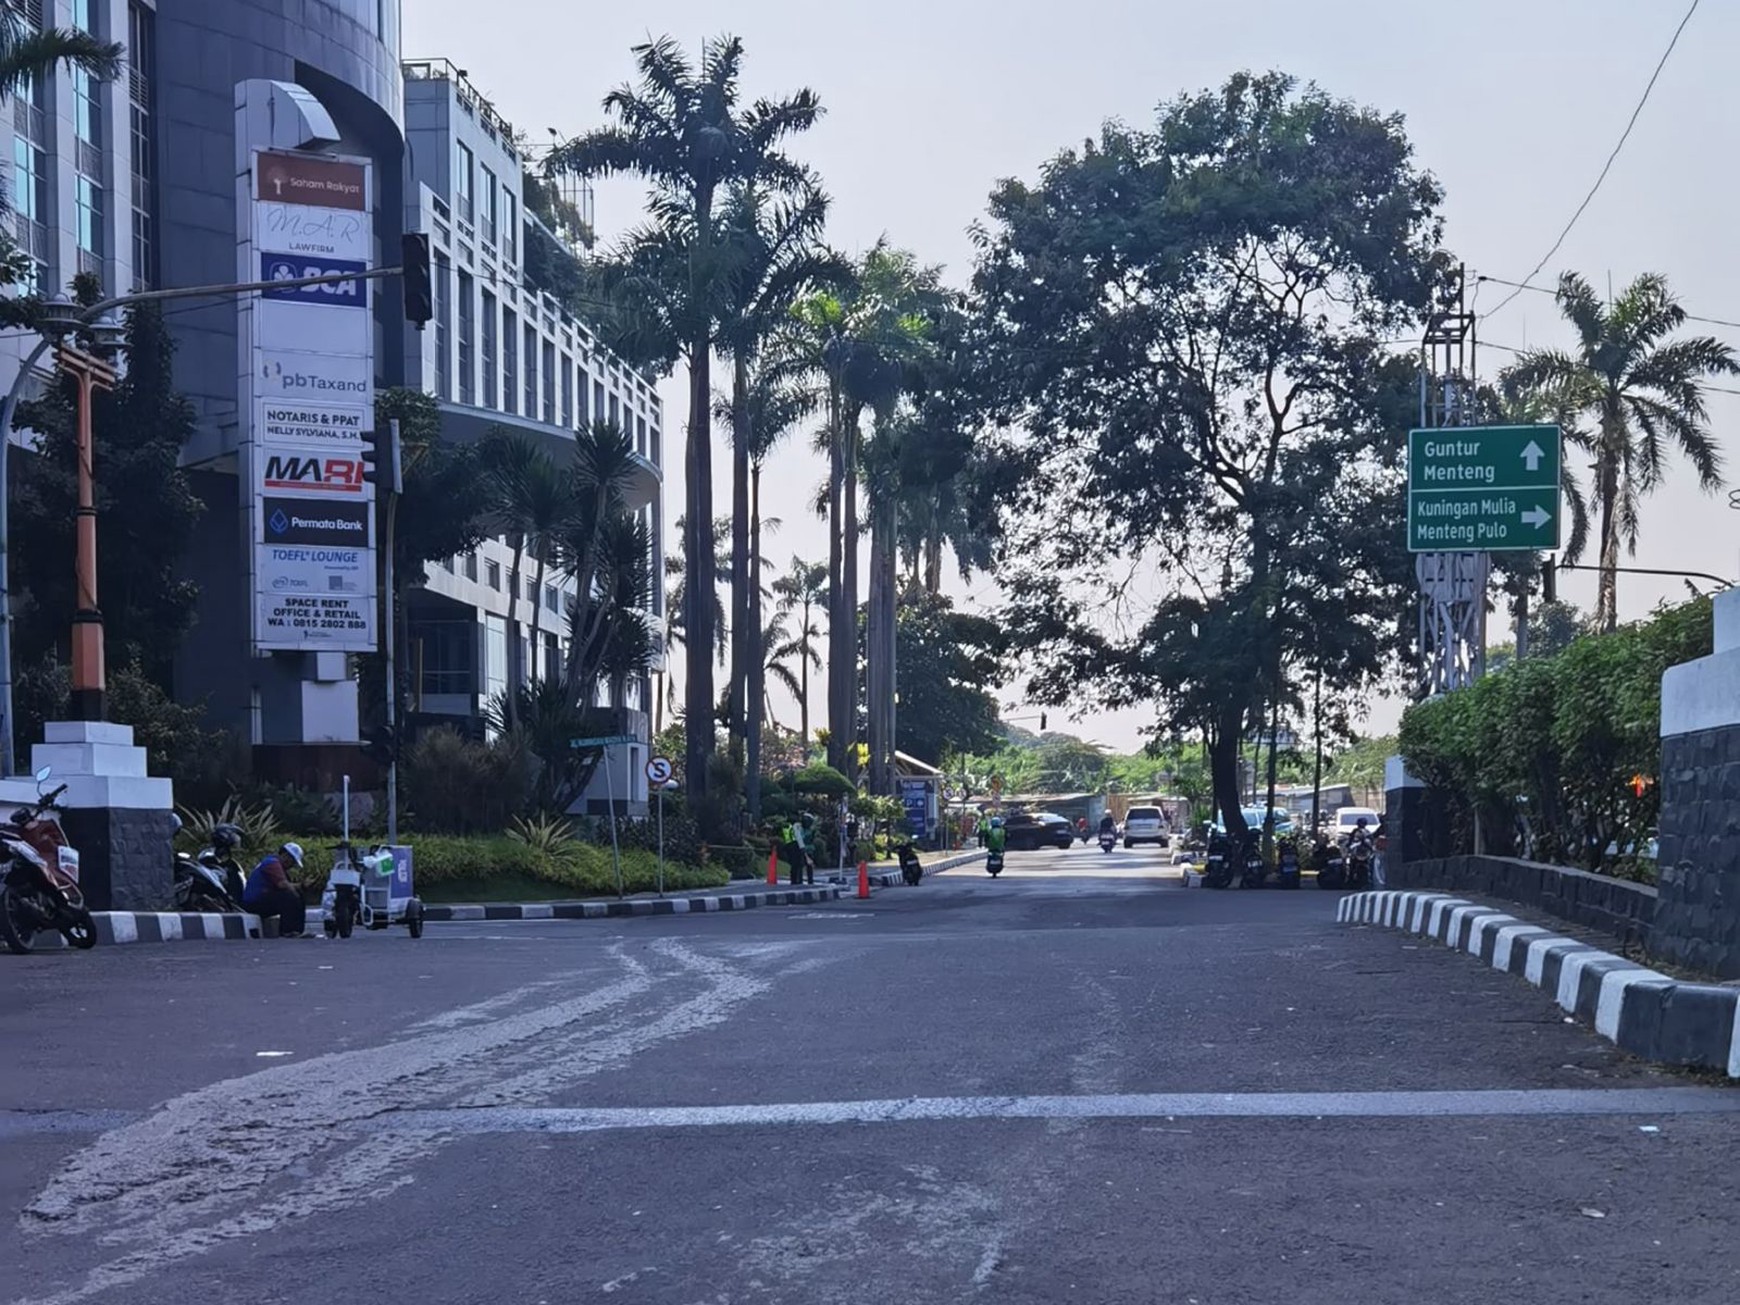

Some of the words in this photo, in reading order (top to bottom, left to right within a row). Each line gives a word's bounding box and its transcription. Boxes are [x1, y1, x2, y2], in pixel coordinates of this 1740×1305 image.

[290, 177, 325, 189] Saham
[326, 180, 359, 193] Rakyat
[288, 242, 334, 253] LAWFIRM
[301, 266, 356, 296] BCA
[282, 373, 367, 392] pbTaxand
[267, 410, 318, 424] NOTARIS
[320, 414, 330, 424] &
[332, 415, 360, 426] PPAT
[267, 426, 294, 436] NELLY
[1424, 441, 1480, 457] Guntur
[1424, 465, 1495, 483] Menteng
[1418, 499, 1478, 519] Kuningan
[1481, 497, 1516, 514] Mulia
[1418, 523, 1474, 542] Menteng
[1477, 522, 1507, 538] Pulo
[311, 551, 358, 563] LOUNGE
[285, 598, 317, 607] SPACE
[321, 600, 349, 608] RENT
[273, 608, 311, 617] OFFICE
[313, 610, 321, 618] &
[325, 610, 360, 619] RETAIL
[267, 618, 284, 626] WA
[293, 619, 318, 628] 0815
[320, 620, 345, 628] 2802
[653, 762, 666, 778] S
